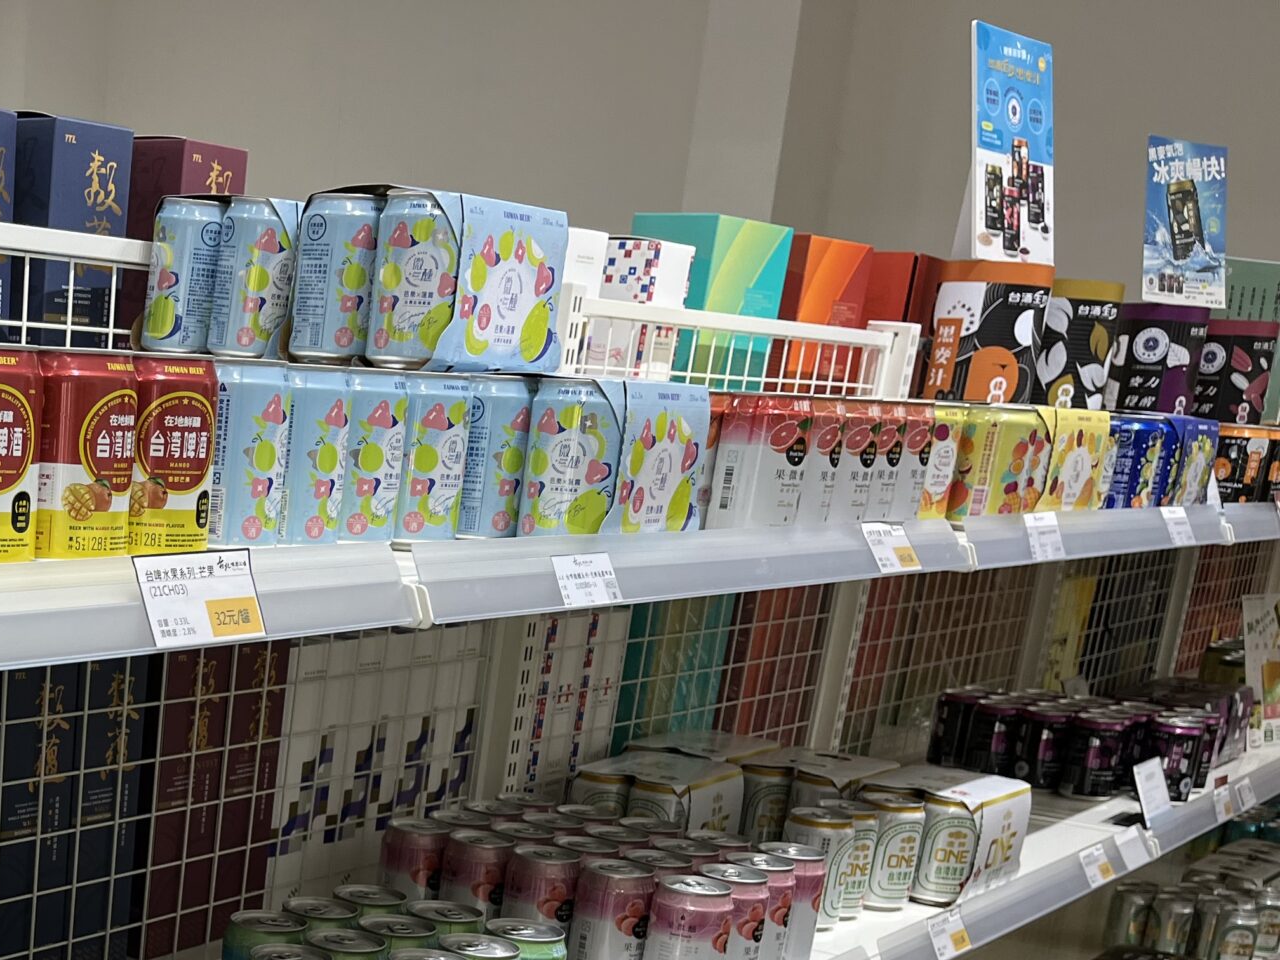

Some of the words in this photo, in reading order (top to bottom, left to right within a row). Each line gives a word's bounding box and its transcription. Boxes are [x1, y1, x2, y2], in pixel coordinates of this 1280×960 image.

[1153, 157, 1225, 184] 冰爽暢快!
[164, 365, 187, 374] TAIWAN
[188, 366, 204, 375] BEER
[165, 415, 201, 428] 在地鮮釀
[145, 565, 215, 583] 台啤水果系列-芒果
[149, 584, 189, 599] (21CH03)
[887, 854, 914, 869] ONE
[935, 848, 968, 864] ONE
